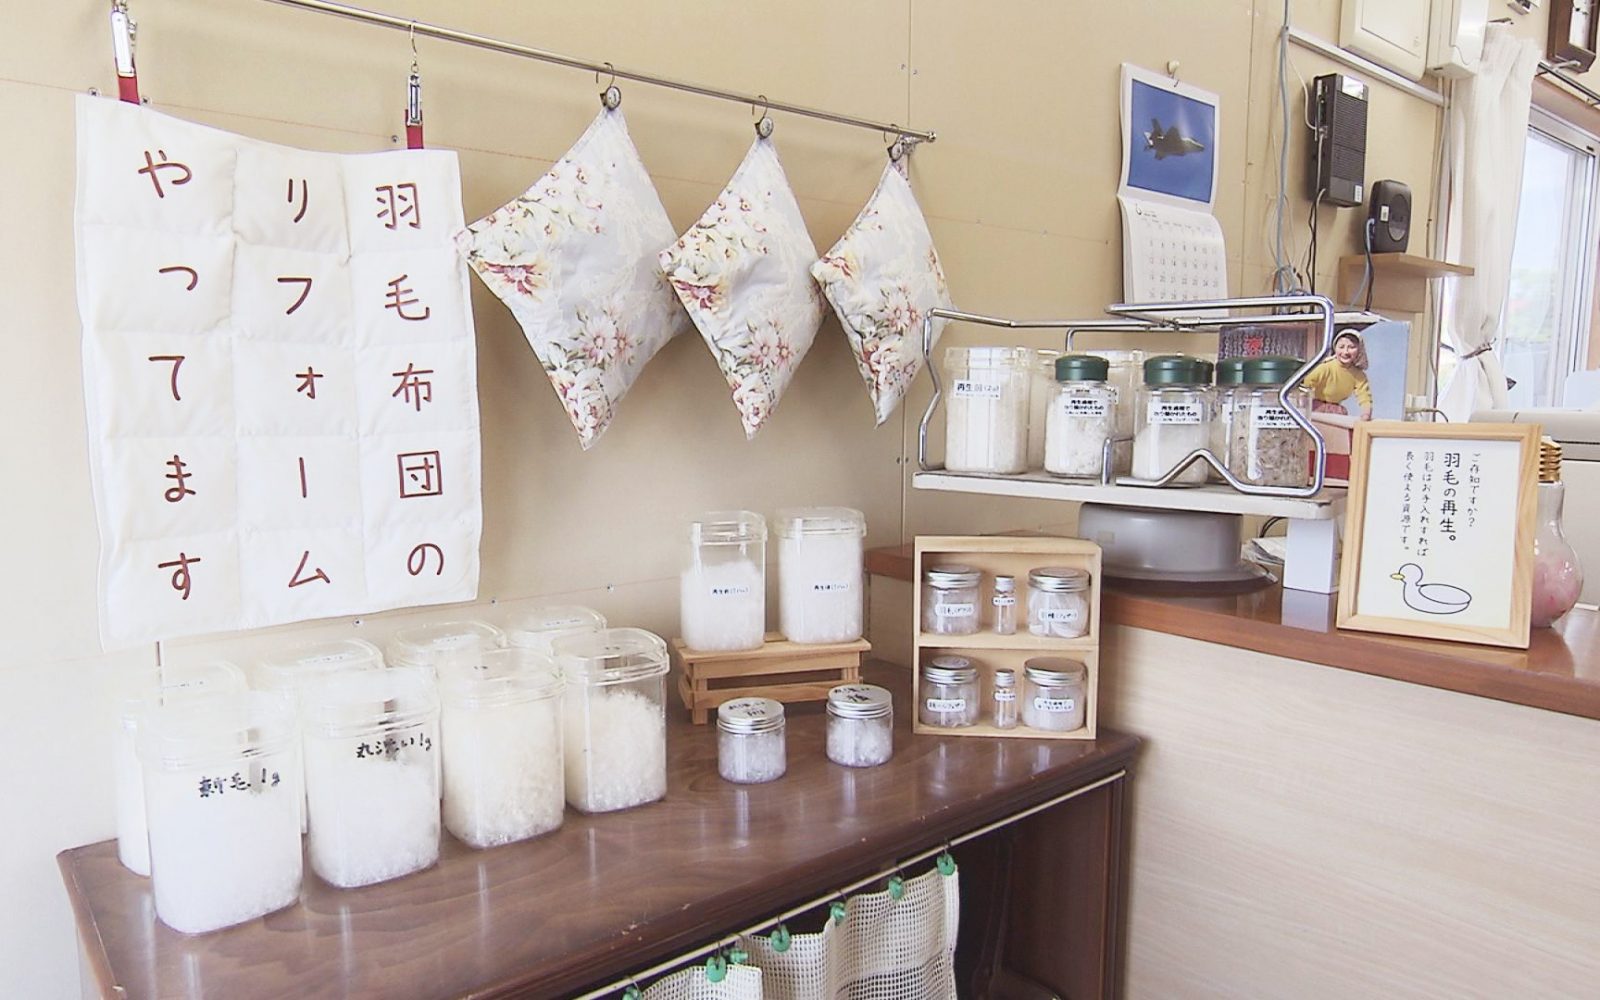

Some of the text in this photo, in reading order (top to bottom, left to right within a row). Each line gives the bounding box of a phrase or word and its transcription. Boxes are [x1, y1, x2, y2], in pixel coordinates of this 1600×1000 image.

[137, 149, 201, 600] やってます
[277, 178, 331, 588] リフォーム
[375, 182, 444, 575] 羽毛布団の
[1416, 451, 1434, 556] 羽毛はお手入れすれば
[1439, 452, 1460, 541] 羽毛の再生。
